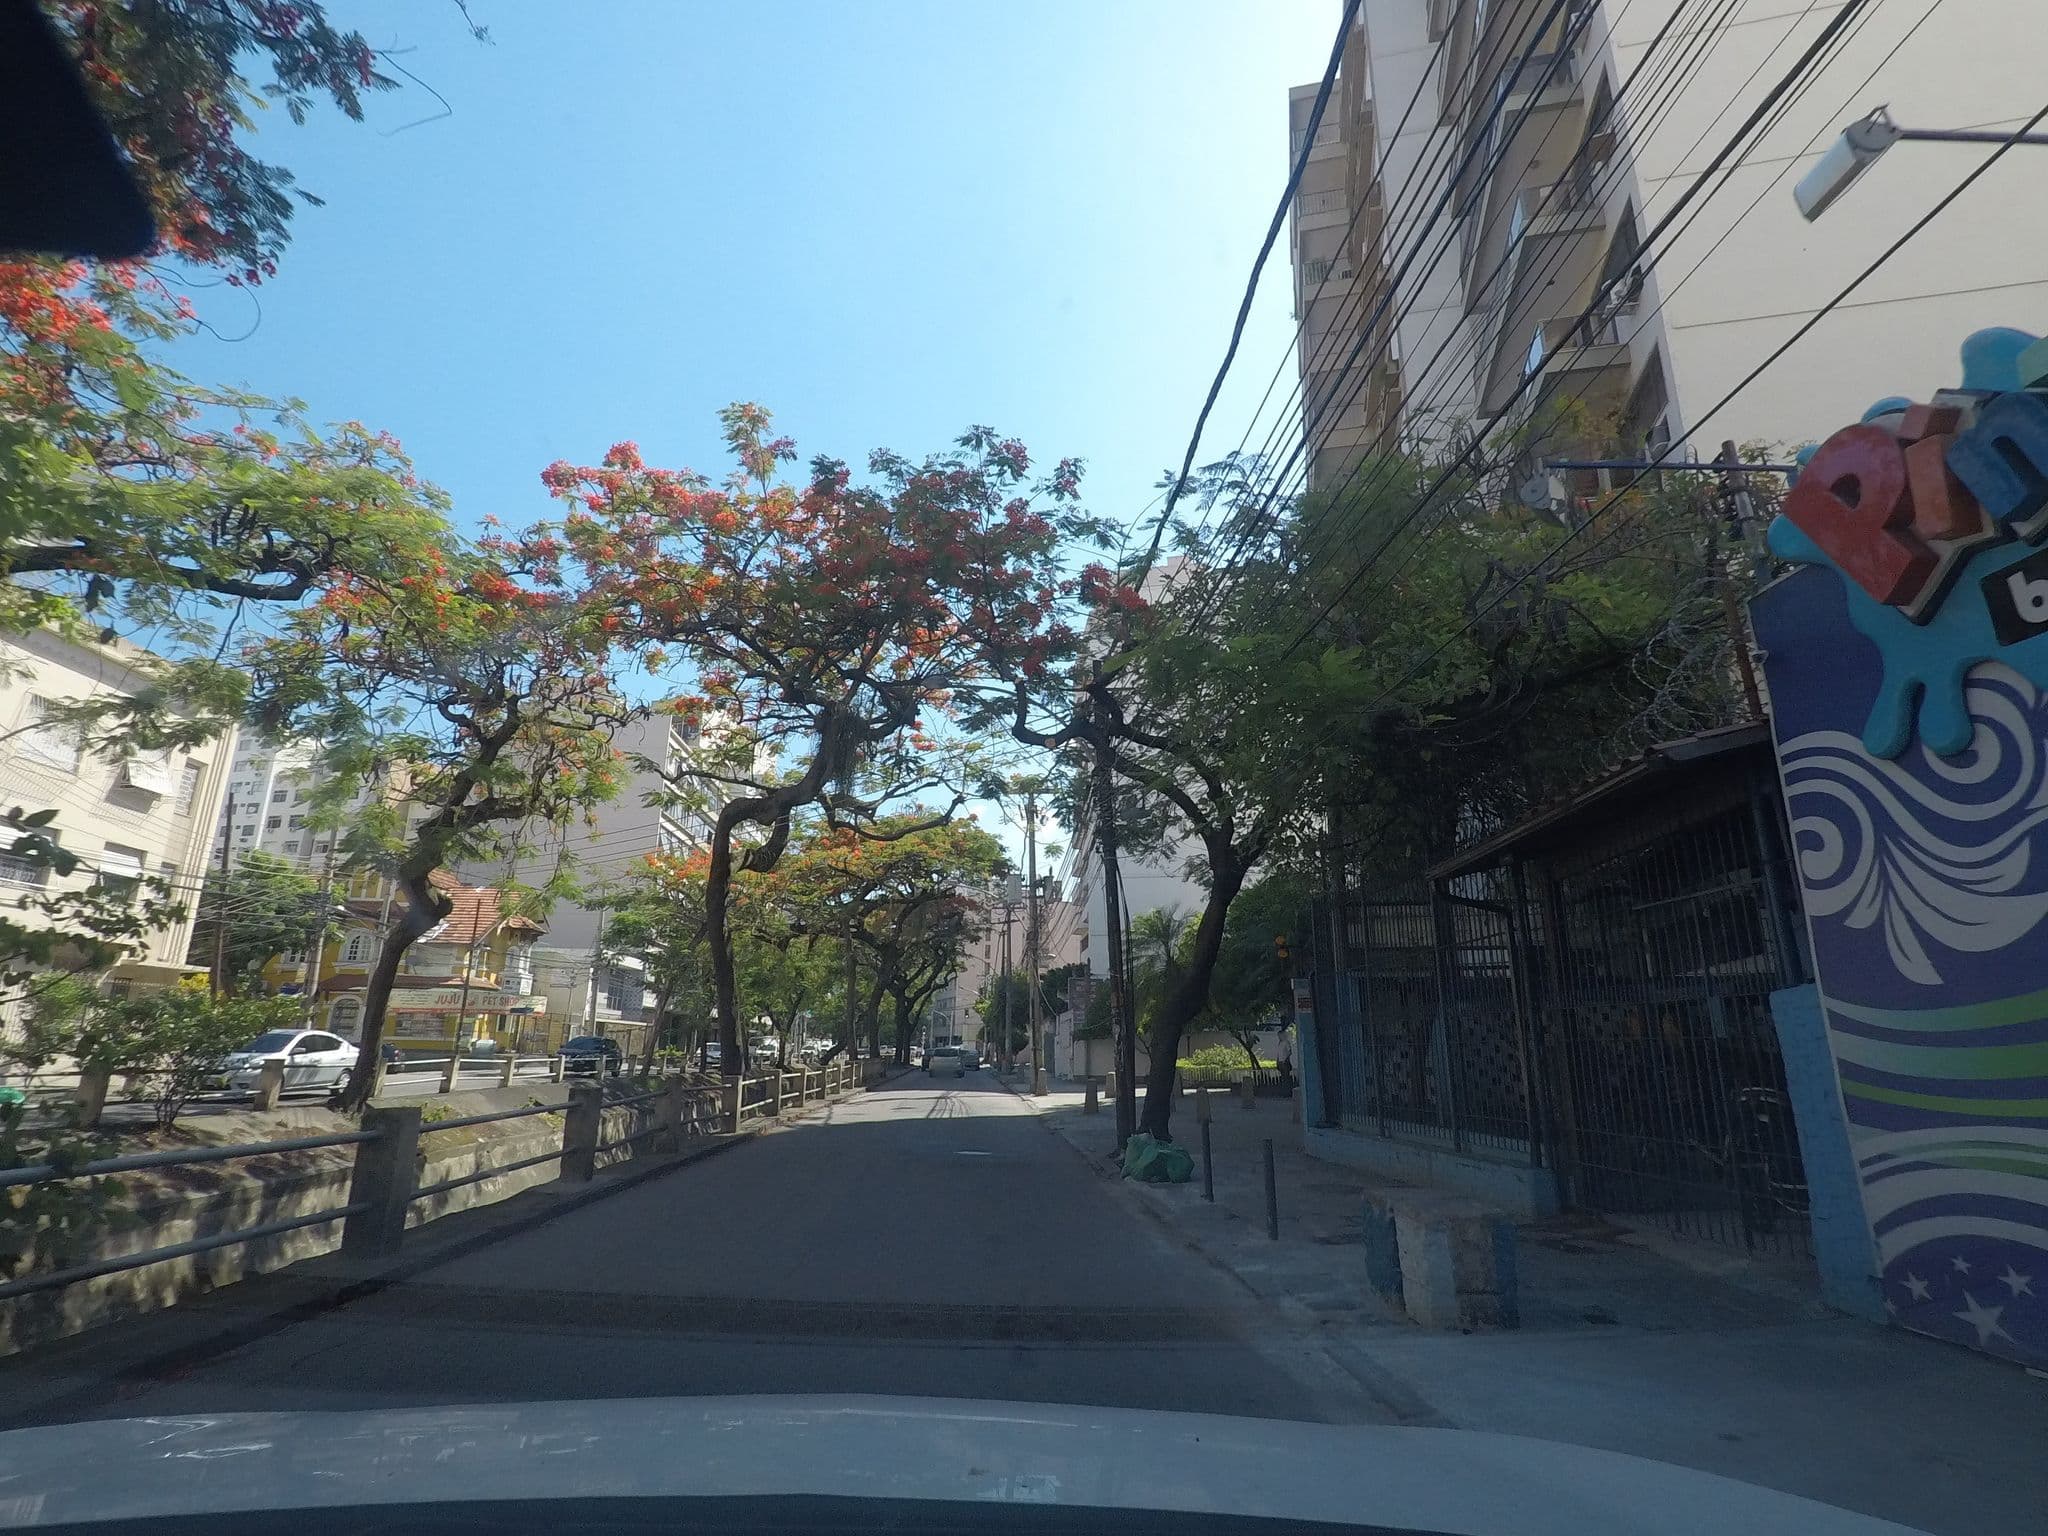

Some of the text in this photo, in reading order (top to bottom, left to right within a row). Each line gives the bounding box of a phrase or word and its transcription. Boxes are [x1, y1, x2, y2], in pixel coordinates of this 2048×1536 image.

[434, 991, 460, 1005] JUJU
[481, 995, 499, 1007] PET
[499, 995, 520, 1008] SHOP
